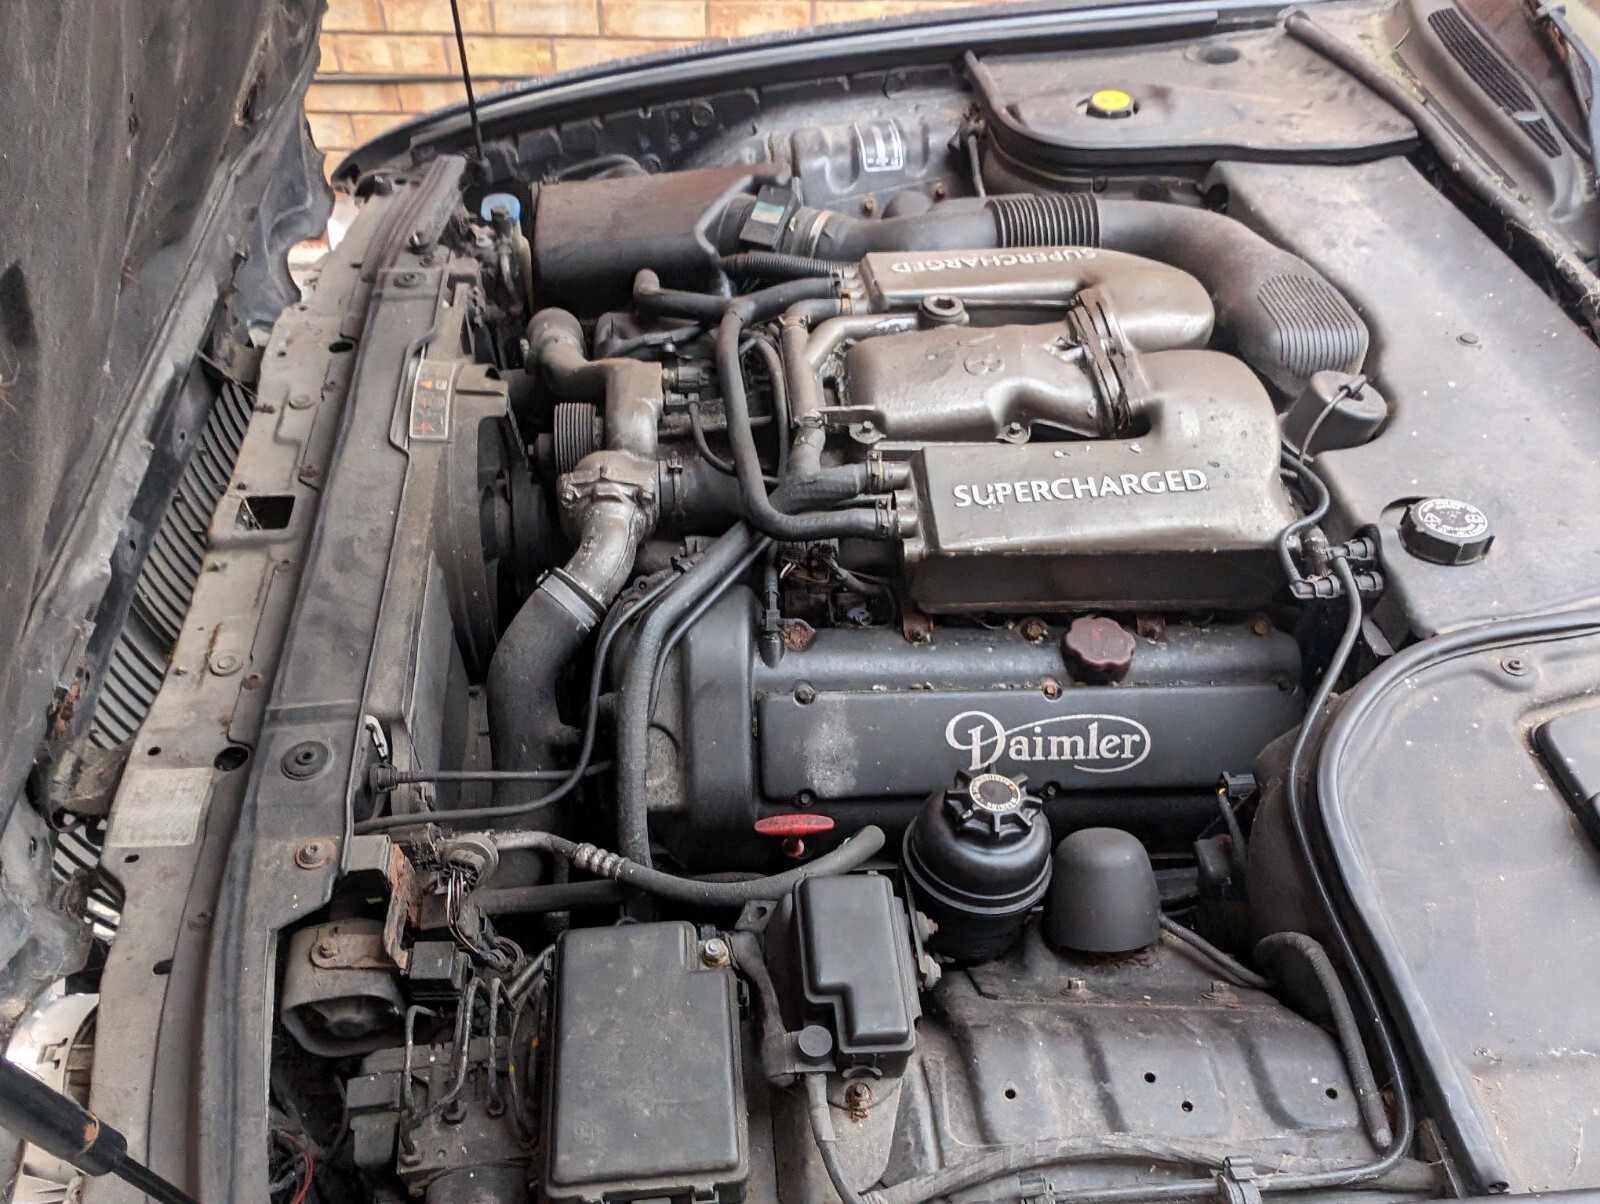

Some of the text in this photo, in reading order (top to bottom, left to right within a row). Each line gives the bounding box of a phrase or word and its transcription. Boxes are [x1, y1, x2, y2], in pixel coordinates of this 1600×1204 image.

[891, 248, 1097, 273] SUPERCHARGED
[953, 469, 1208, 508] SUPERCHARGED
[946, 711, 1151, 773] Daimler
